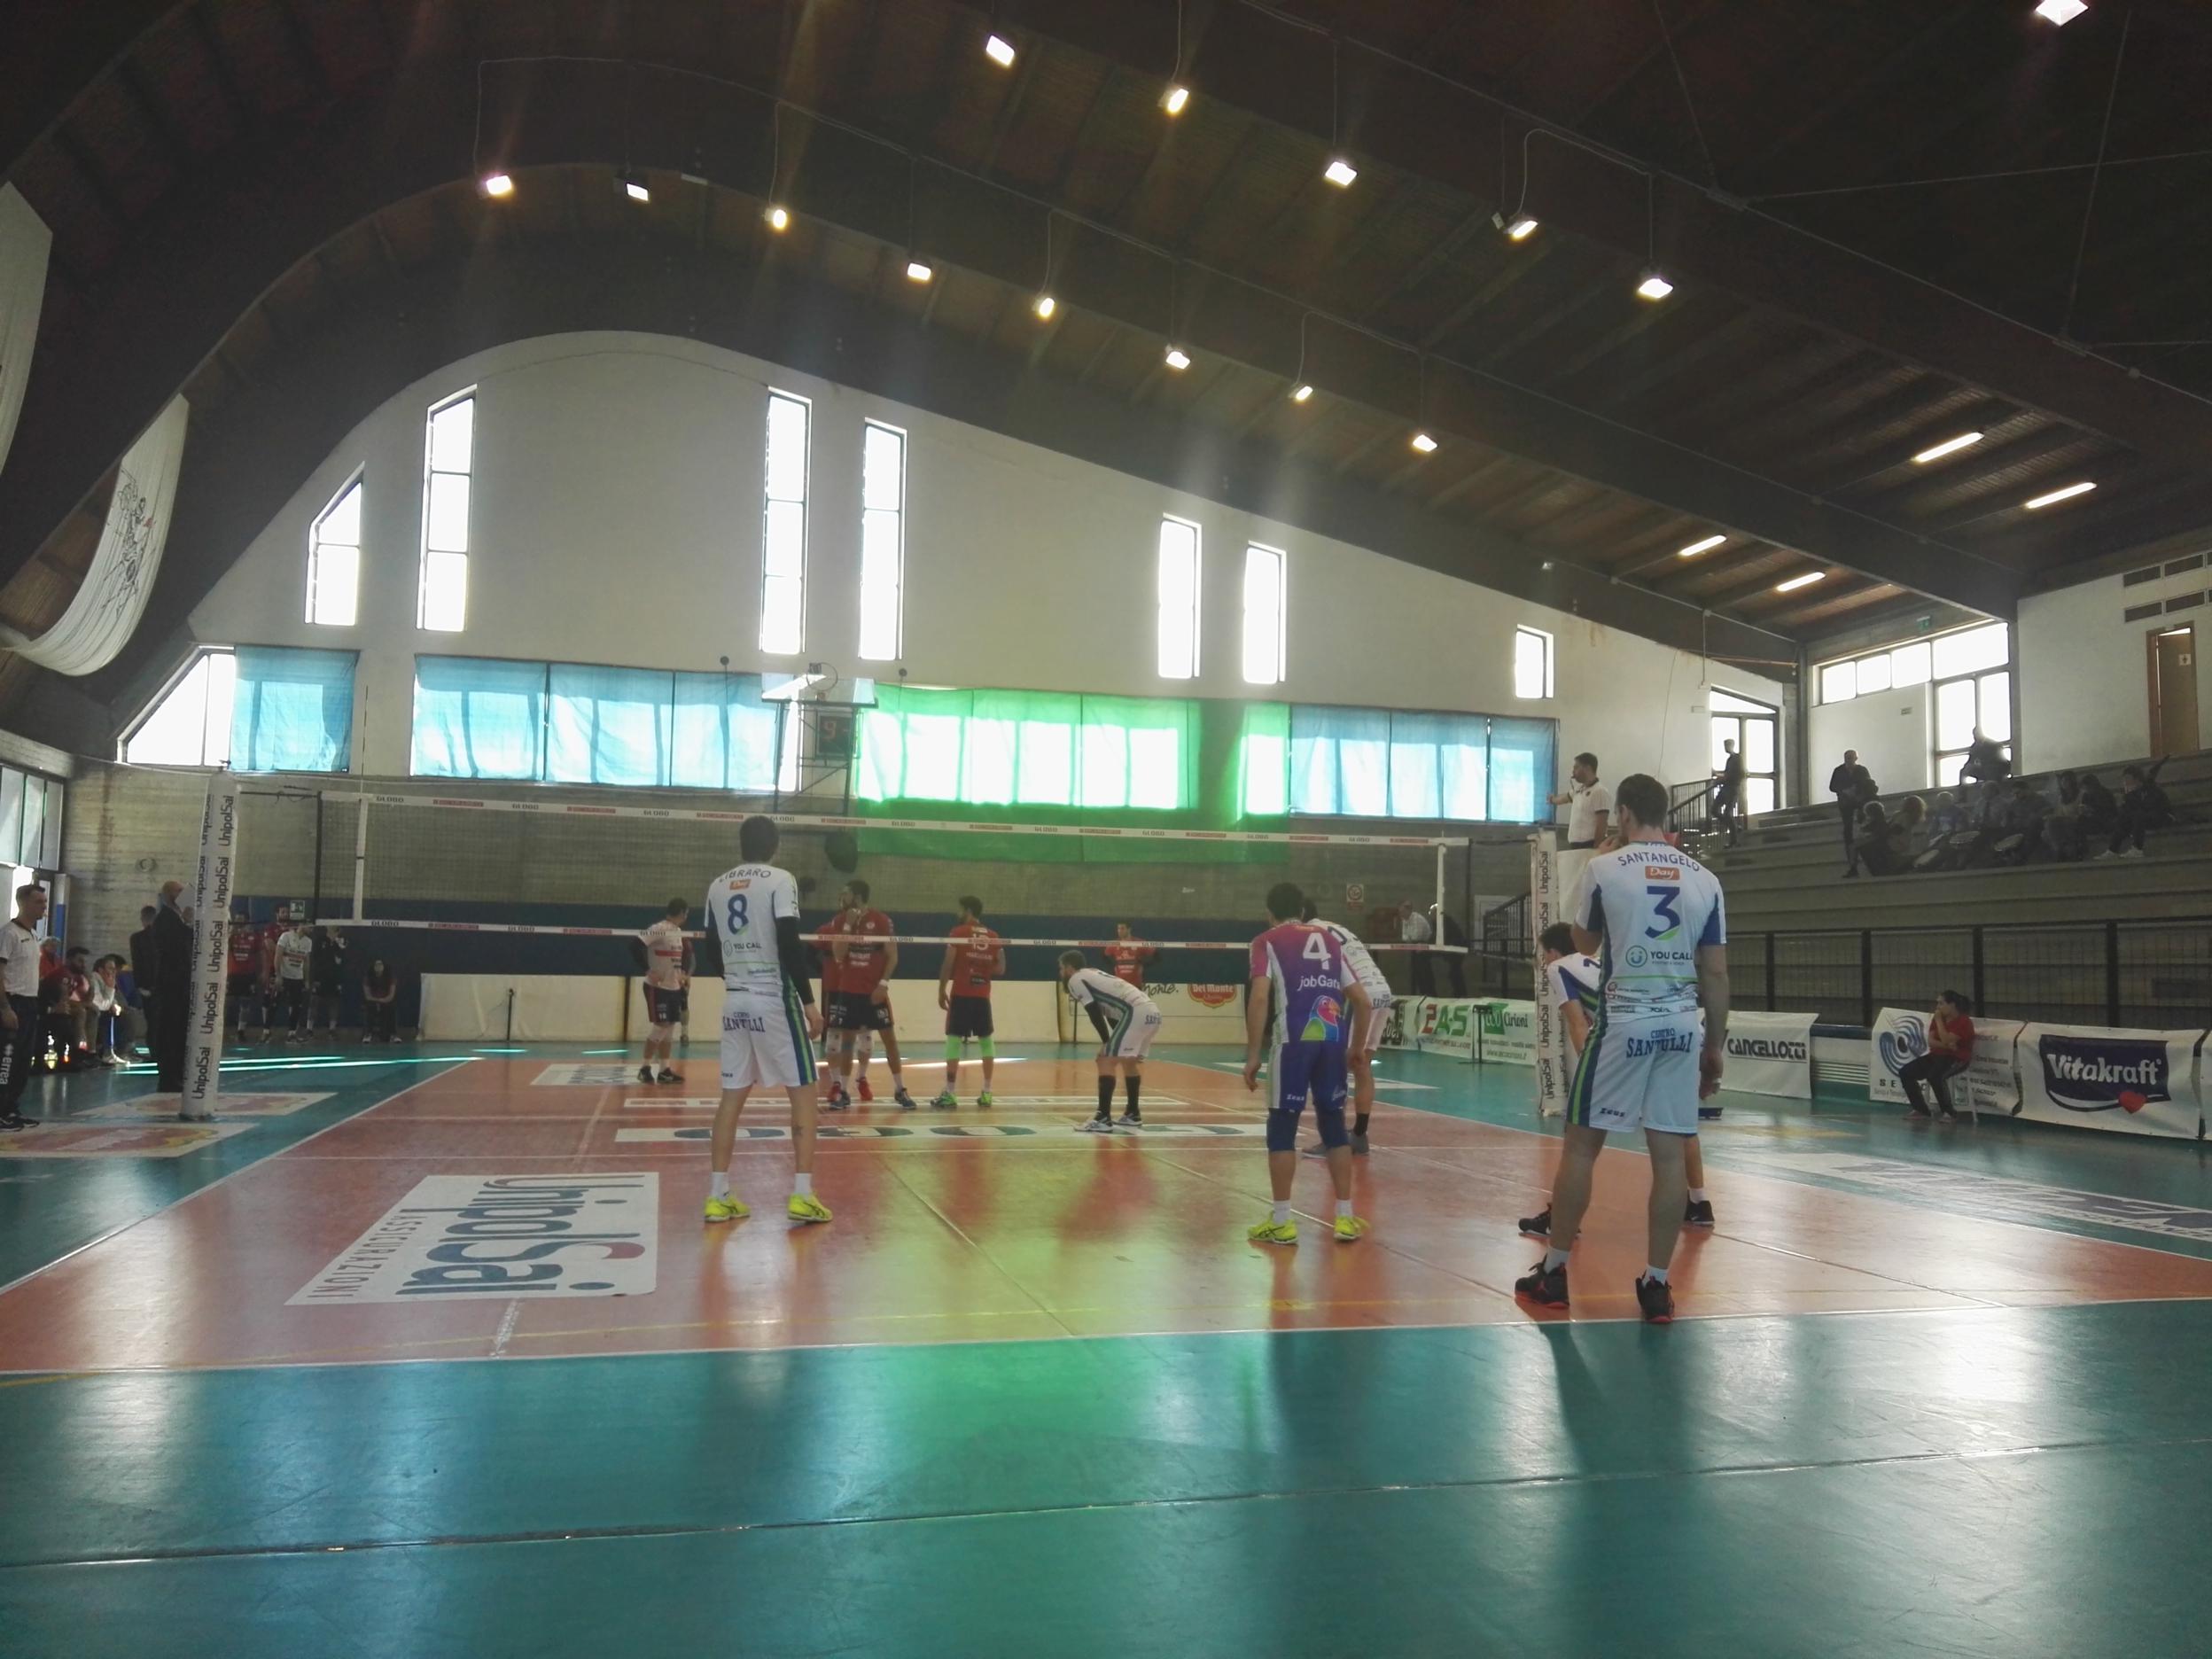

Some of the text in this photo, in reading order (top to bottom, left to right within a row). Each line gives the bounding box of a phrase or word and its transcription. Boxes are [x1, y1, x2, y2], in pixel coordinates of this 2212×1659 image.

[219, 795, 234, 846] UnipolSai
[213, 856, 229, 908] UnipolSai
[1539, 852, 1550, 893] UnipolSai
[1617, 851, 1700, 872] SANTANGELO
[1649, 868, 1675, 880] Day
[728, 893, 749, 936] 8
[1645, 885, 1681, 940] 3
[206, 921, 223, 972] UnipolSai
[1303, 932, 1331, 970] 4
[1650, 951, 1671, 960] YOU
[199, 983, 218, 1034] UnipolSai
[1539, 1005, 1552, 1048] UnipolSai
[191, 1047, 211, 1099] UnipolSai
[1541, 1058, 1554, 1099] UnipolSai
[2047, 1053, 2161, 1085] Vitakraft
[395, 1175, 645, 1295] UnipolSai
